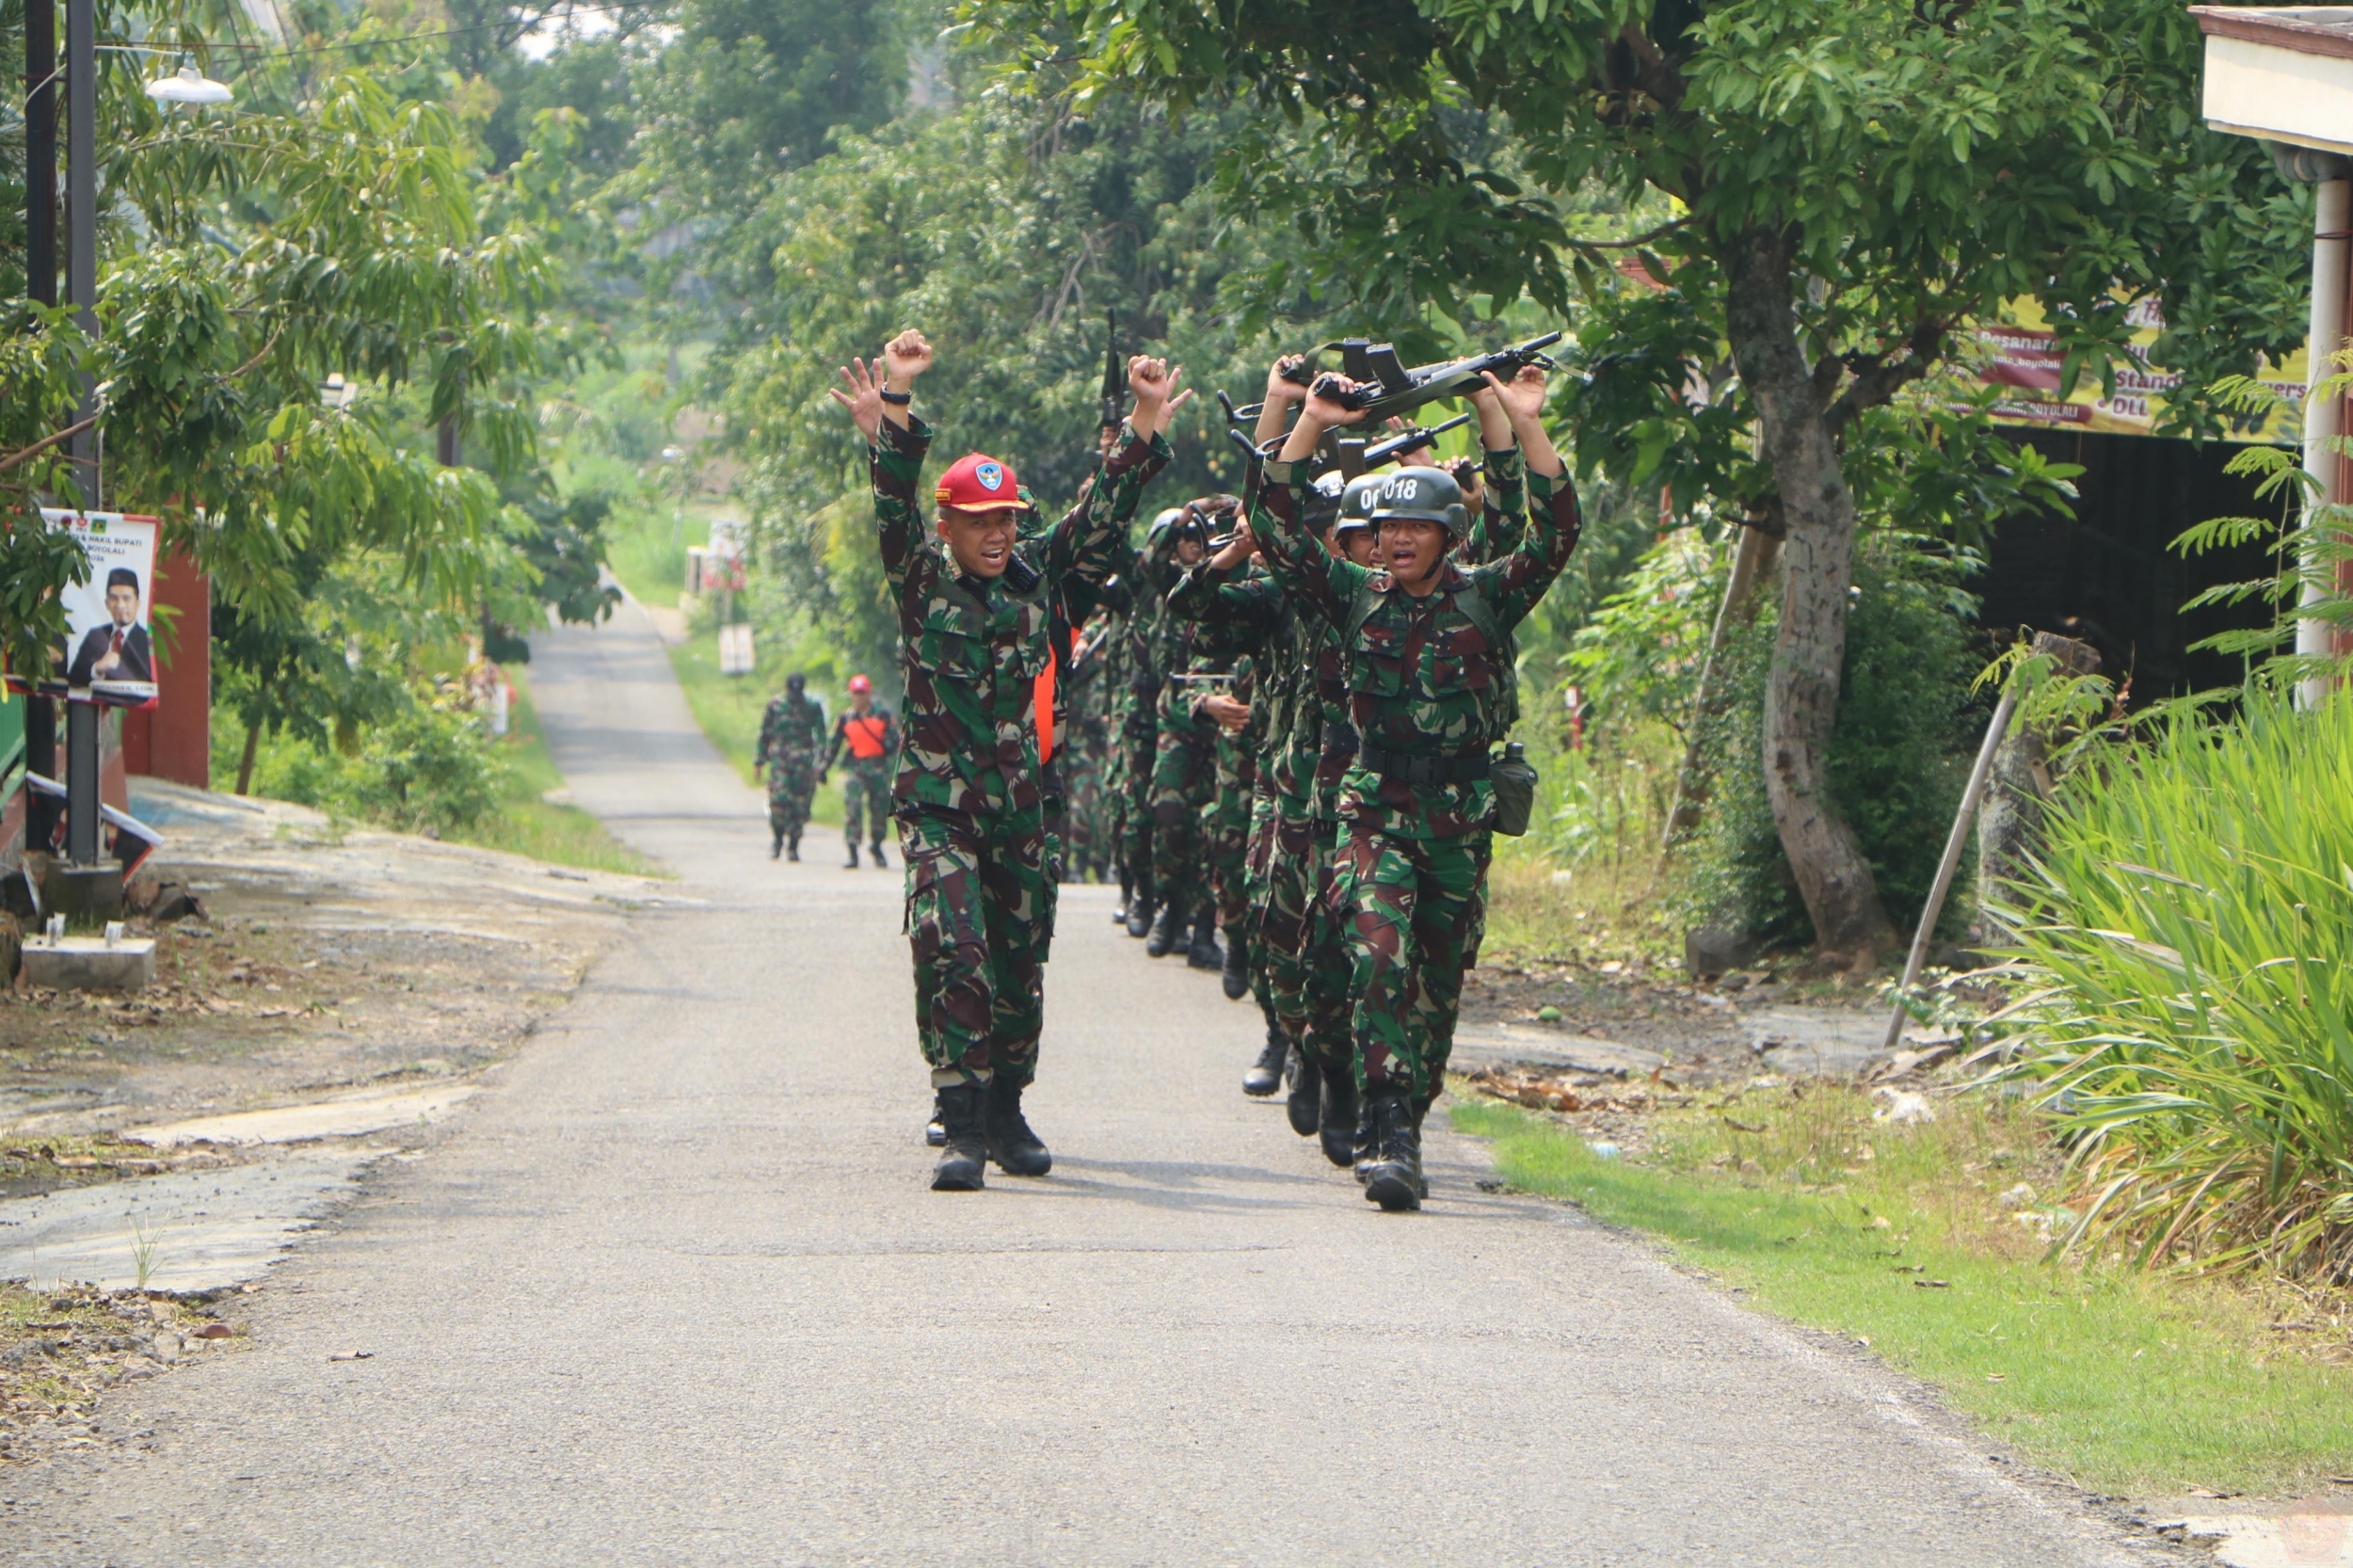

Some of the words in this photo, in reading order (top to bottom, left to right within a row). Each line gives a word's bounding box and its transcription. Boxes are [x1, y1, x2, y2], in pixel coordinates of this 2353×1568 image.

[2114, 397, 2149, 416] DLL
[1385, 478, 1417, 500] 018
[88, 535, 112, 544] WAKIL
[114, 537, 142, 546] BUPATI
[88, 544, 125, 554] BOYOLALI
